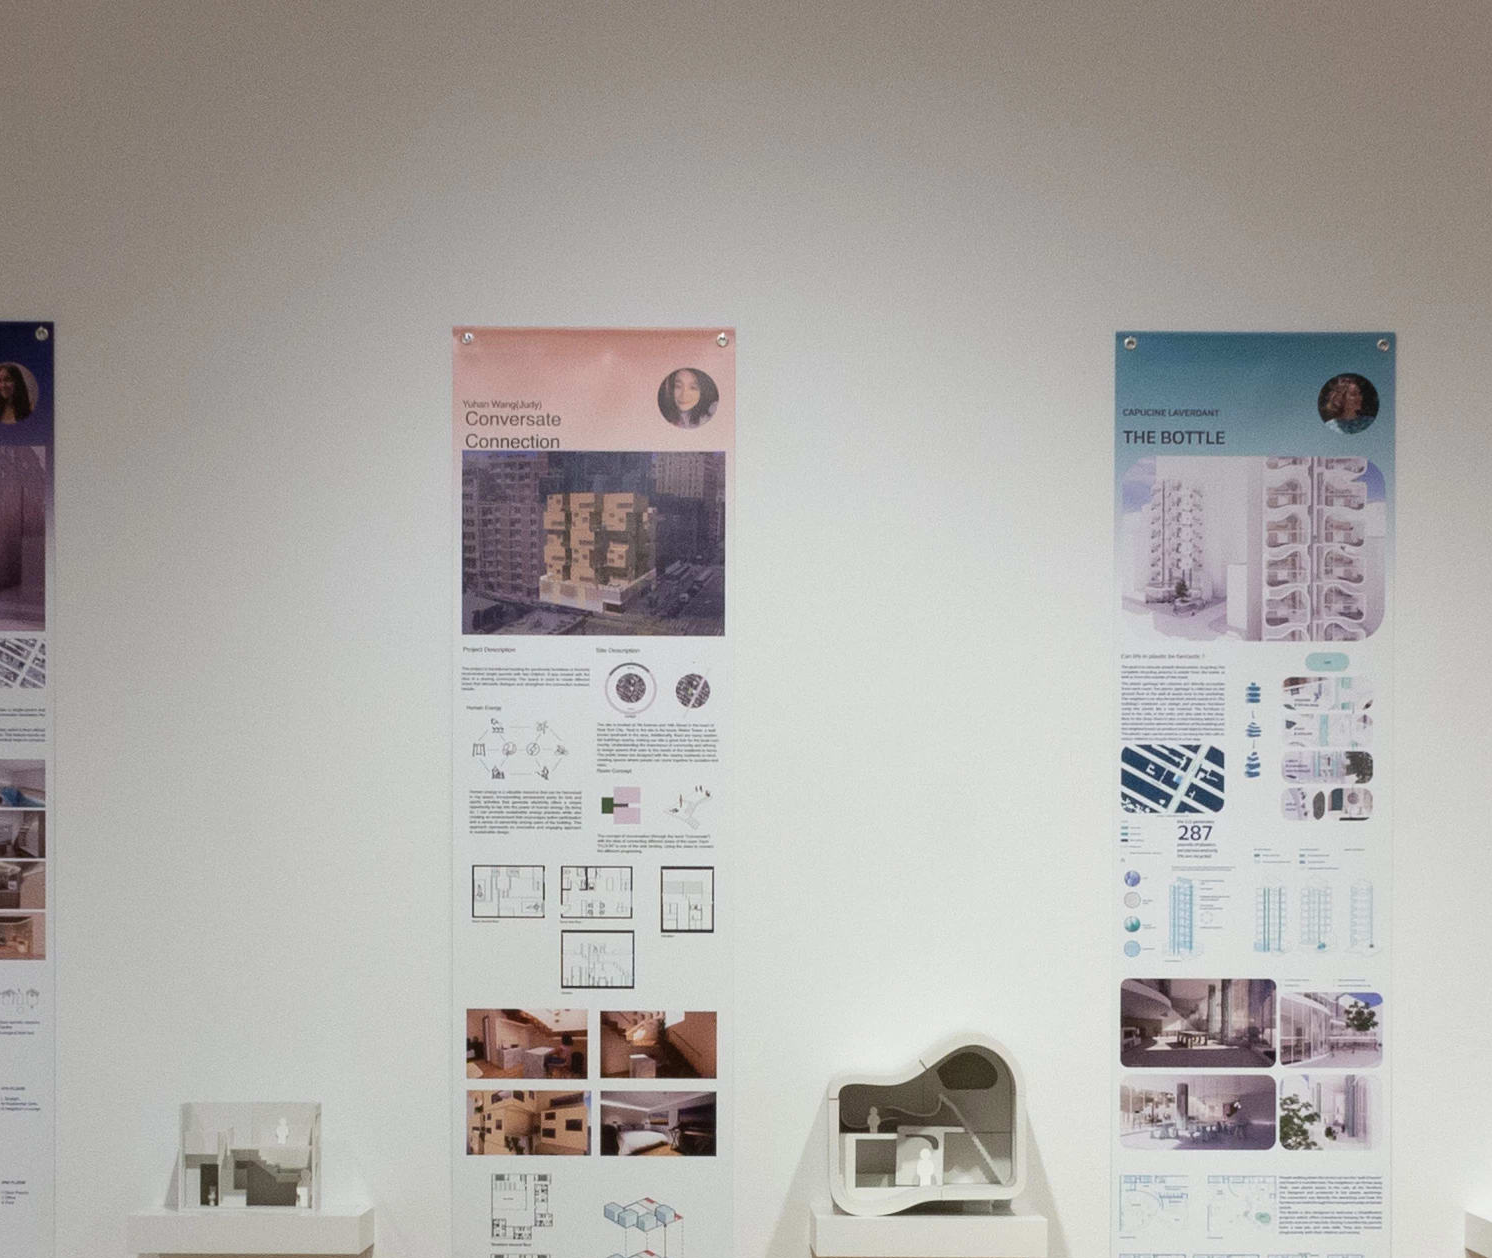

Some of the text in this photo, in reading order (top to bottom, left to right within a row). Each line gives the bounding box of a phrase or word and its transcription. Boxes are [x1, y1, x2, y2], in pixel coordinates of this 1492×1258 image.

[465, 410, 561, 427] Conversate
[465, 433, 560, 449] Connection
[1123, 430, 1225, 445] THE BOTTLE
[1178, 825, 1212, 841] 287
